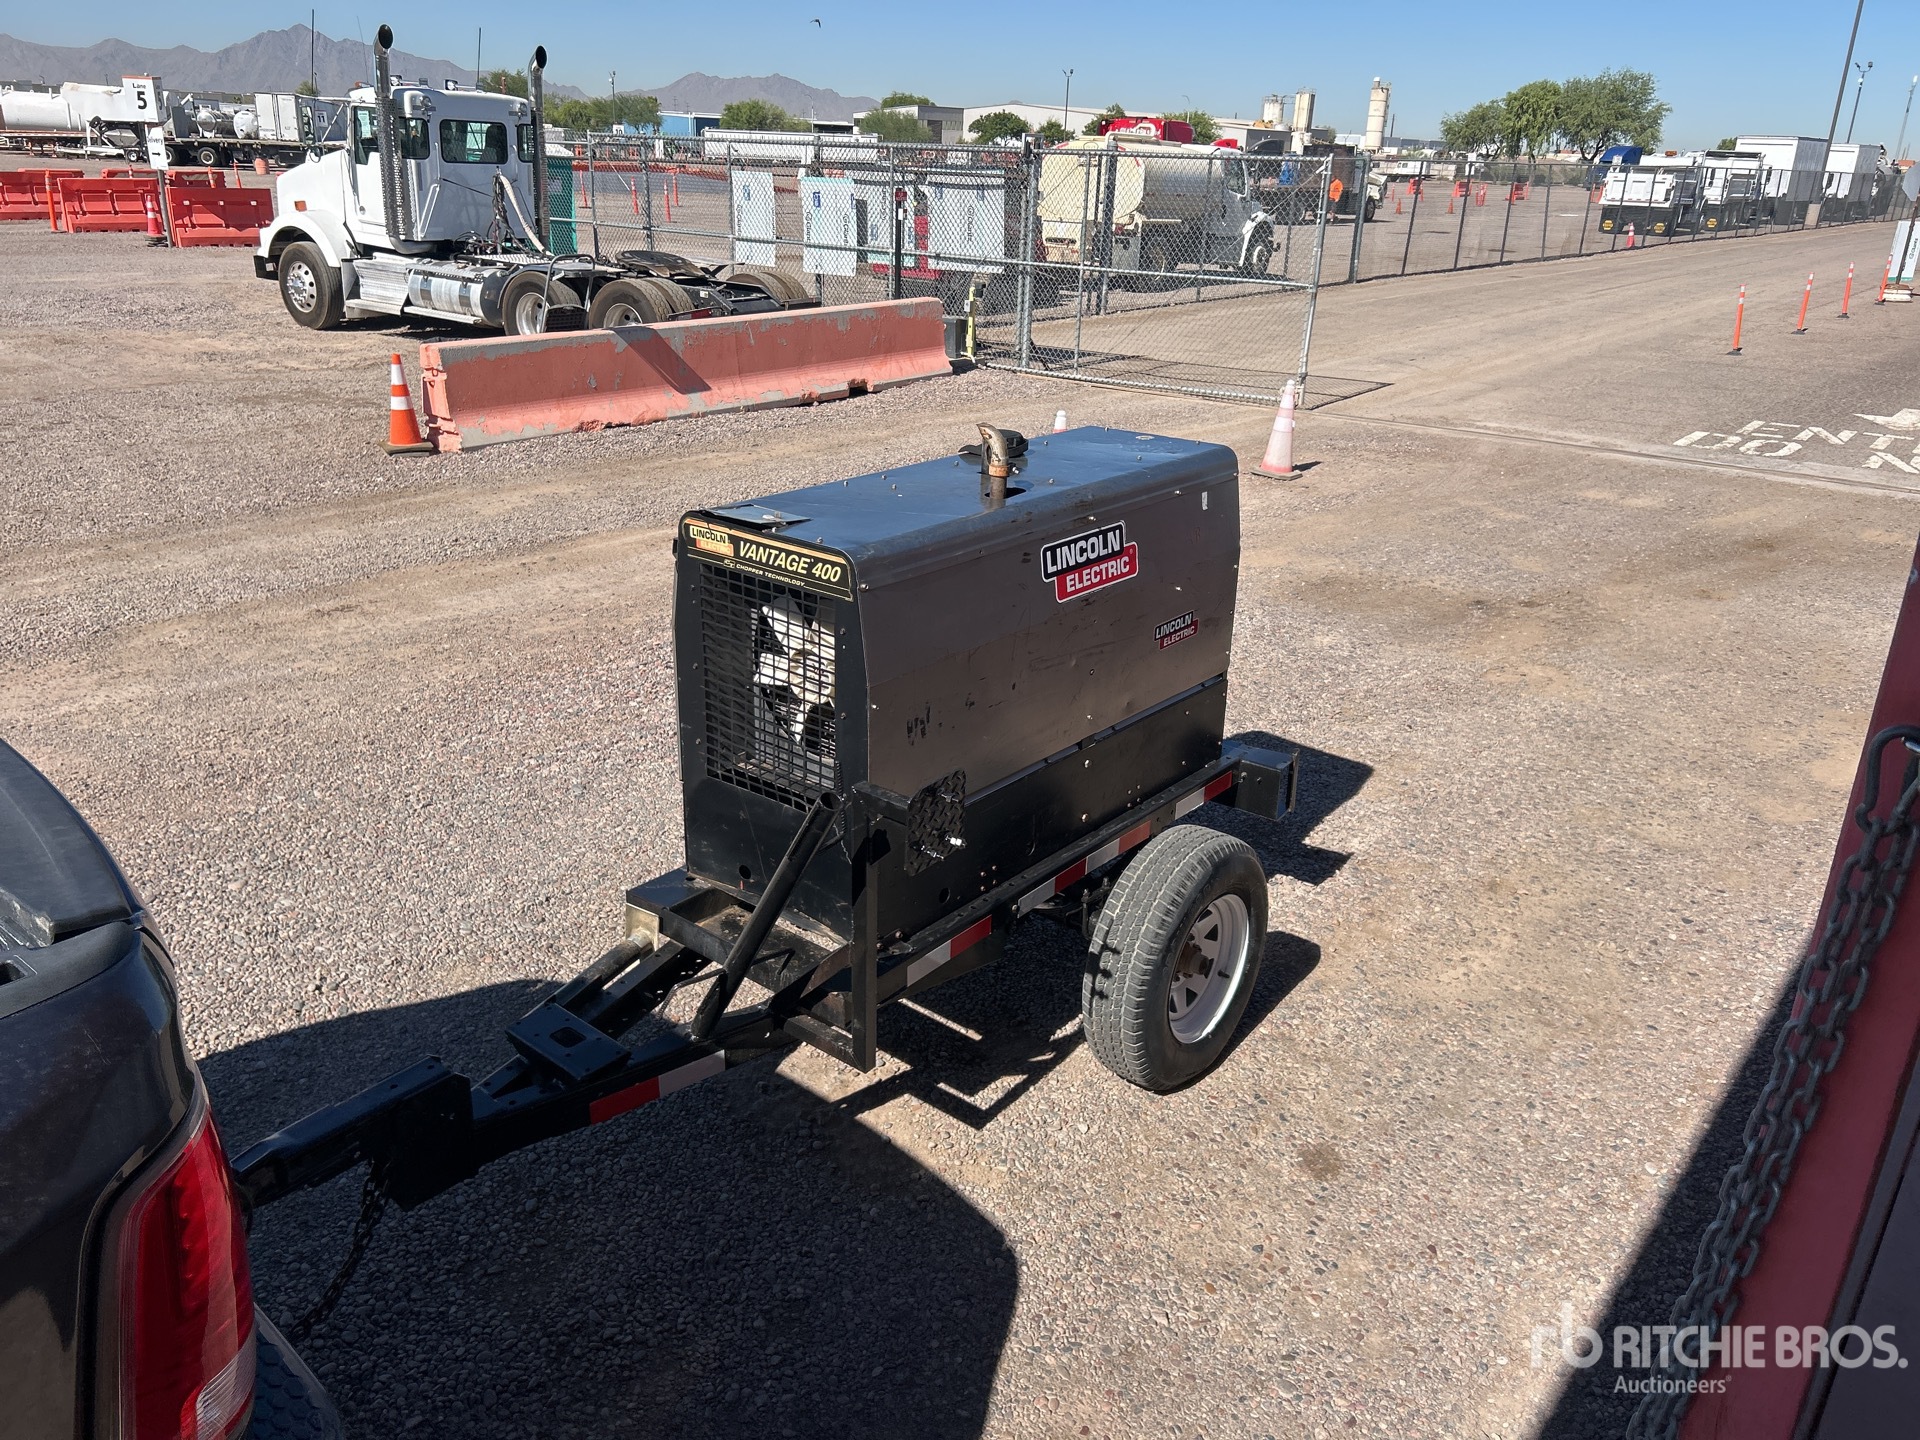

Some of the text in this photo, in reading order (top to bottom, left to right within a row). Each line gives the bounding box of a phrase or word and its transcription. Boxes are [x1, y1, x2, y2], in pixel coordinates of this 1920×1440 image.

[136, 90, 147, 110] 5
[317, 115, 325, 123] 11
[1672, 430, 1803, 457] DO
[1736, 419, 1920, 455] ENT
[691, 527, 727, 544] LINCOLN
[739, 541, 842, 582] VANTAGE 400
[1046, 529, 1121, 574] LINCOLN
[736, 563, 764, 576] CHOPPER
[764, 571, 806, 588] TECHNOLOGY
[1065, 555, 1131, 593] ELECTRIC
[1155, 613, 1193, 640] LINCOLN
[1163, 625, 1196, 647] ELECTRIC
